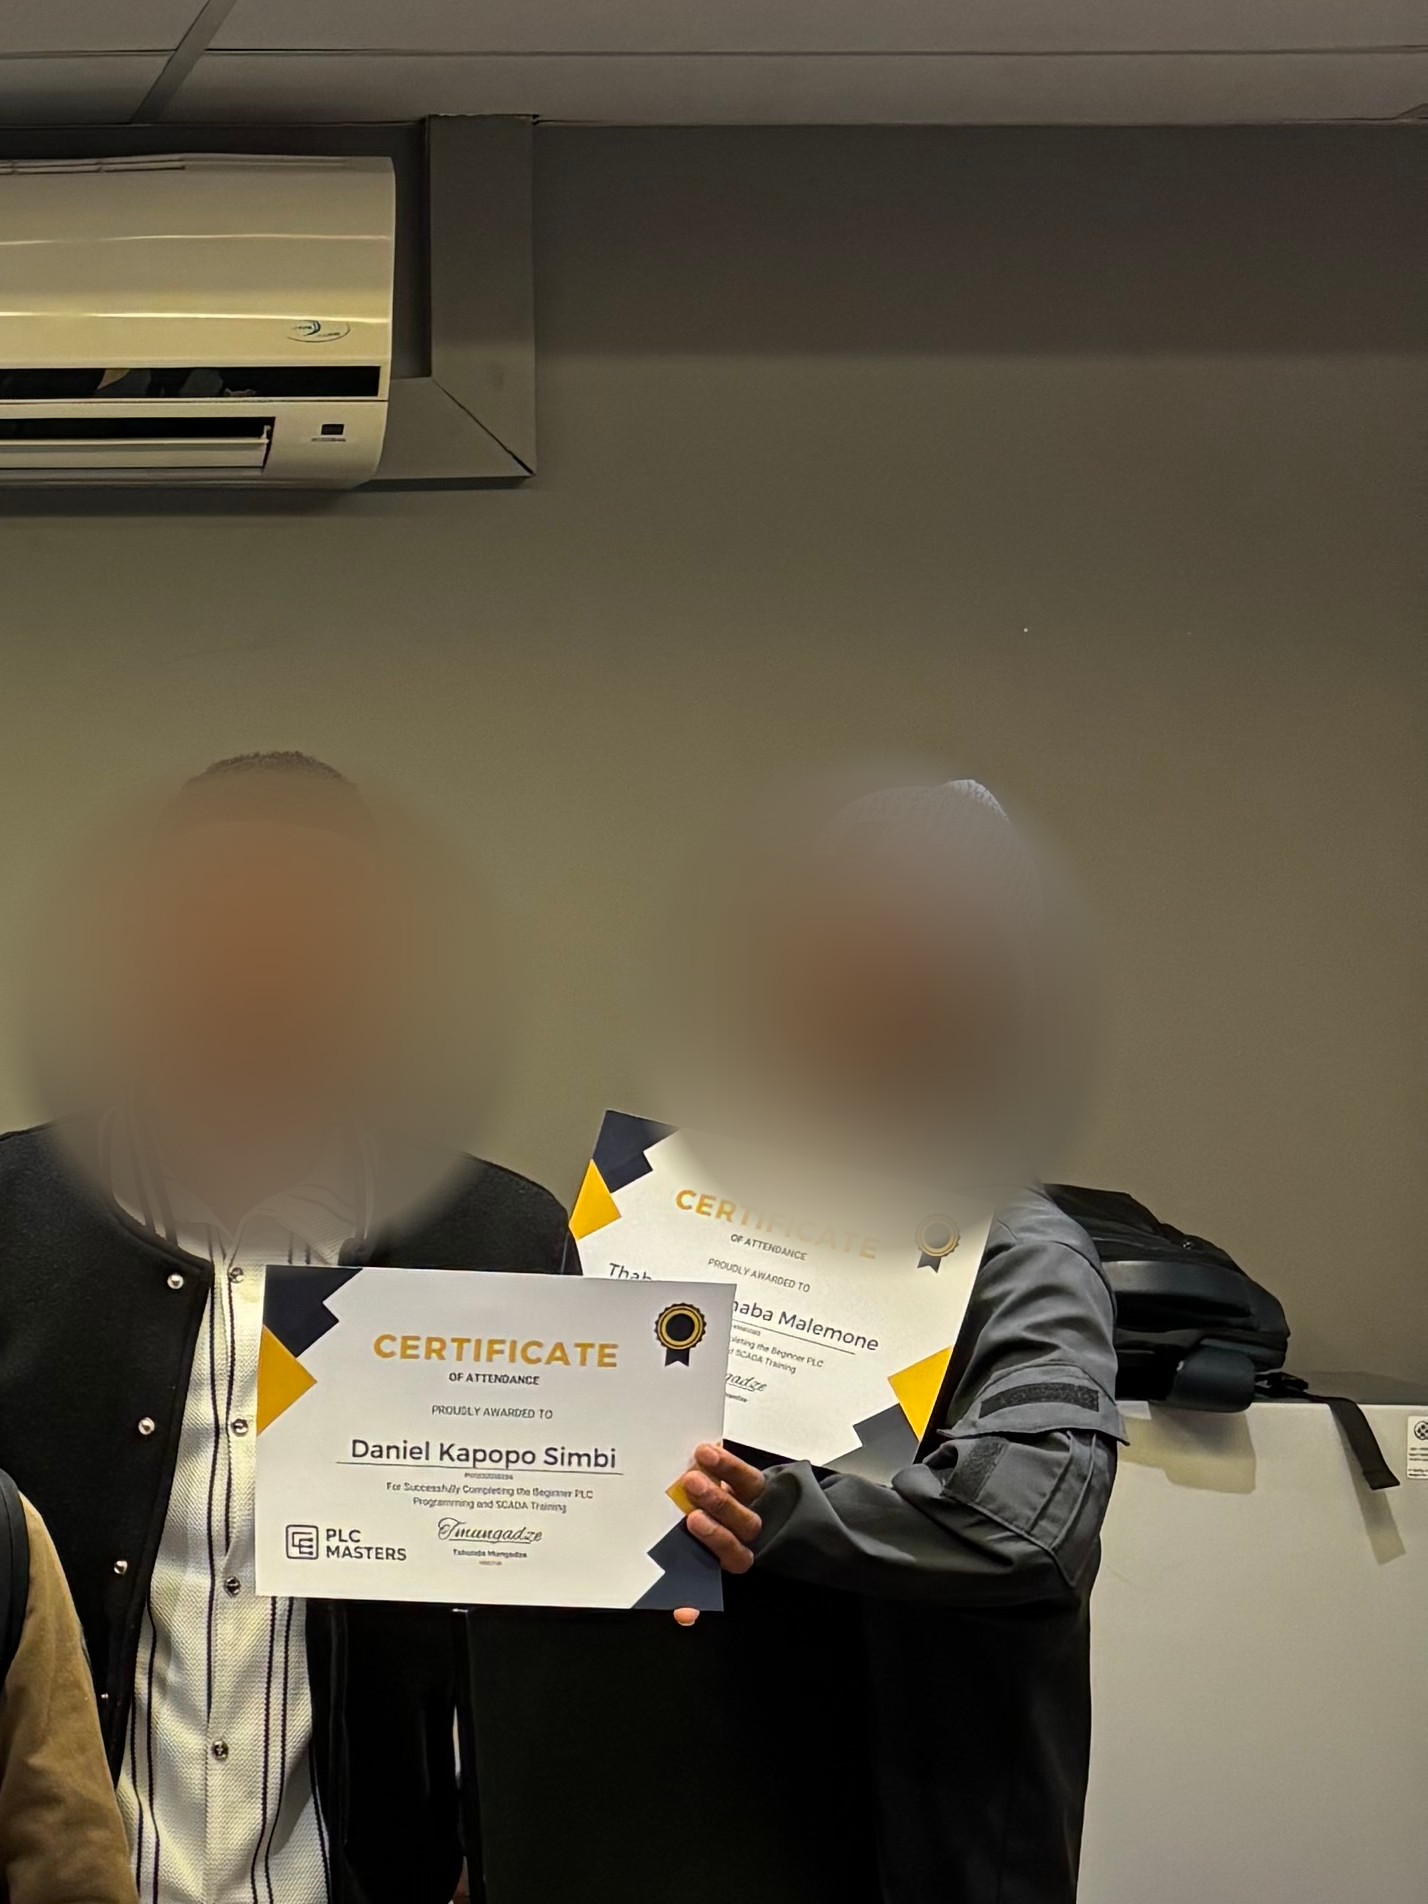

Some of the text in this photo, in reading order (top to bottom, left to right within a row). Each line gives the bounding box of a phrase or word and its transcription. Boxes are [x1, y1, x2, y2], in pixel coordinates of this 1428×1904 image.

[778, 1311, 878, 1350] Malemone
[374, 1334, 619, 1367] CERTIFICATE
[449, 1372, 540, 1385] OF ATTENDANCE
[432, 1405, 553, 1419] PROUDLY AWARDED TO
[352, 1439, 615, 1471] Daniel Kapopo Simbi
[326, 1528, 361, 1543] PLC
[326, 1545, 406, 1561] MASTERS
